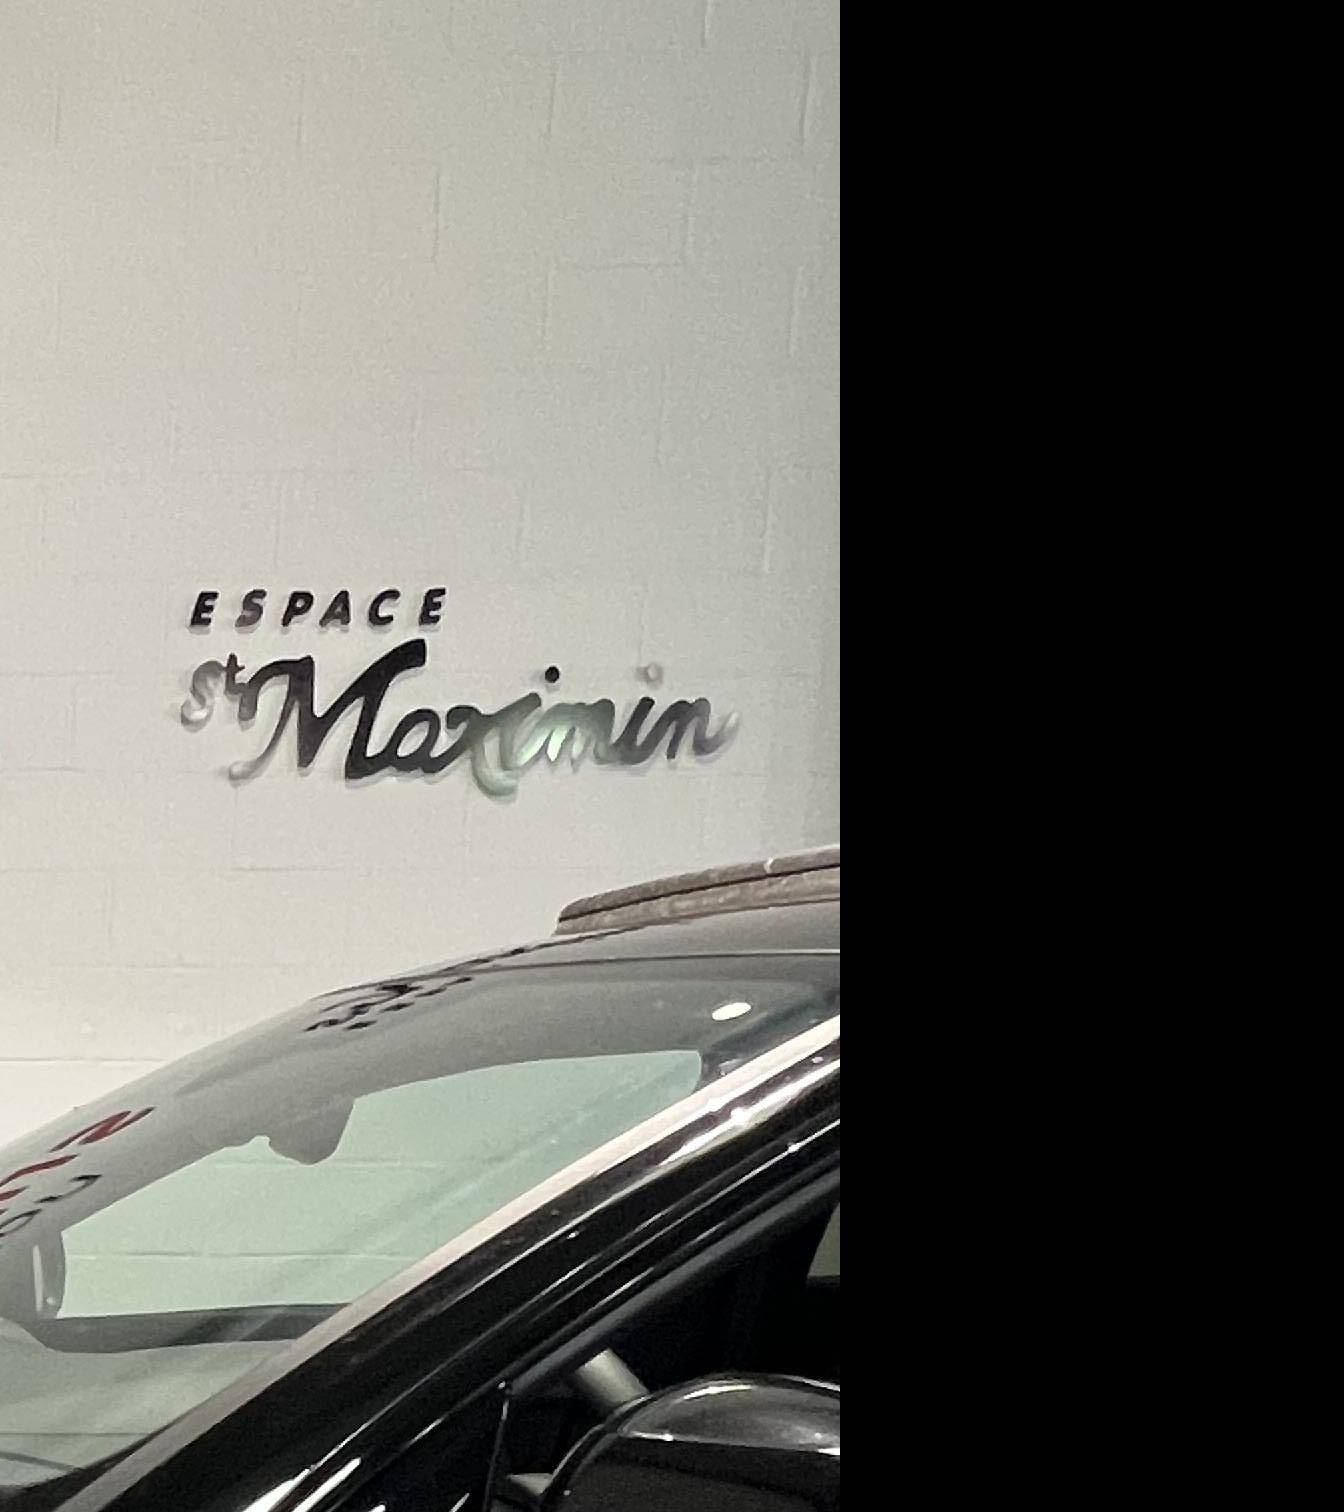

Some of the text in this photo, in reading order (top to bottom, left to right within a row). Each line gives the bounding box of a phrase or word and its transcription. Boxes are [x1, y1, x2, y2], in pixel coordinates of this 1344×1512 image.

[188, 586, 448, 630] ESPACE
[180, 638, 740, 803] St Maximin
